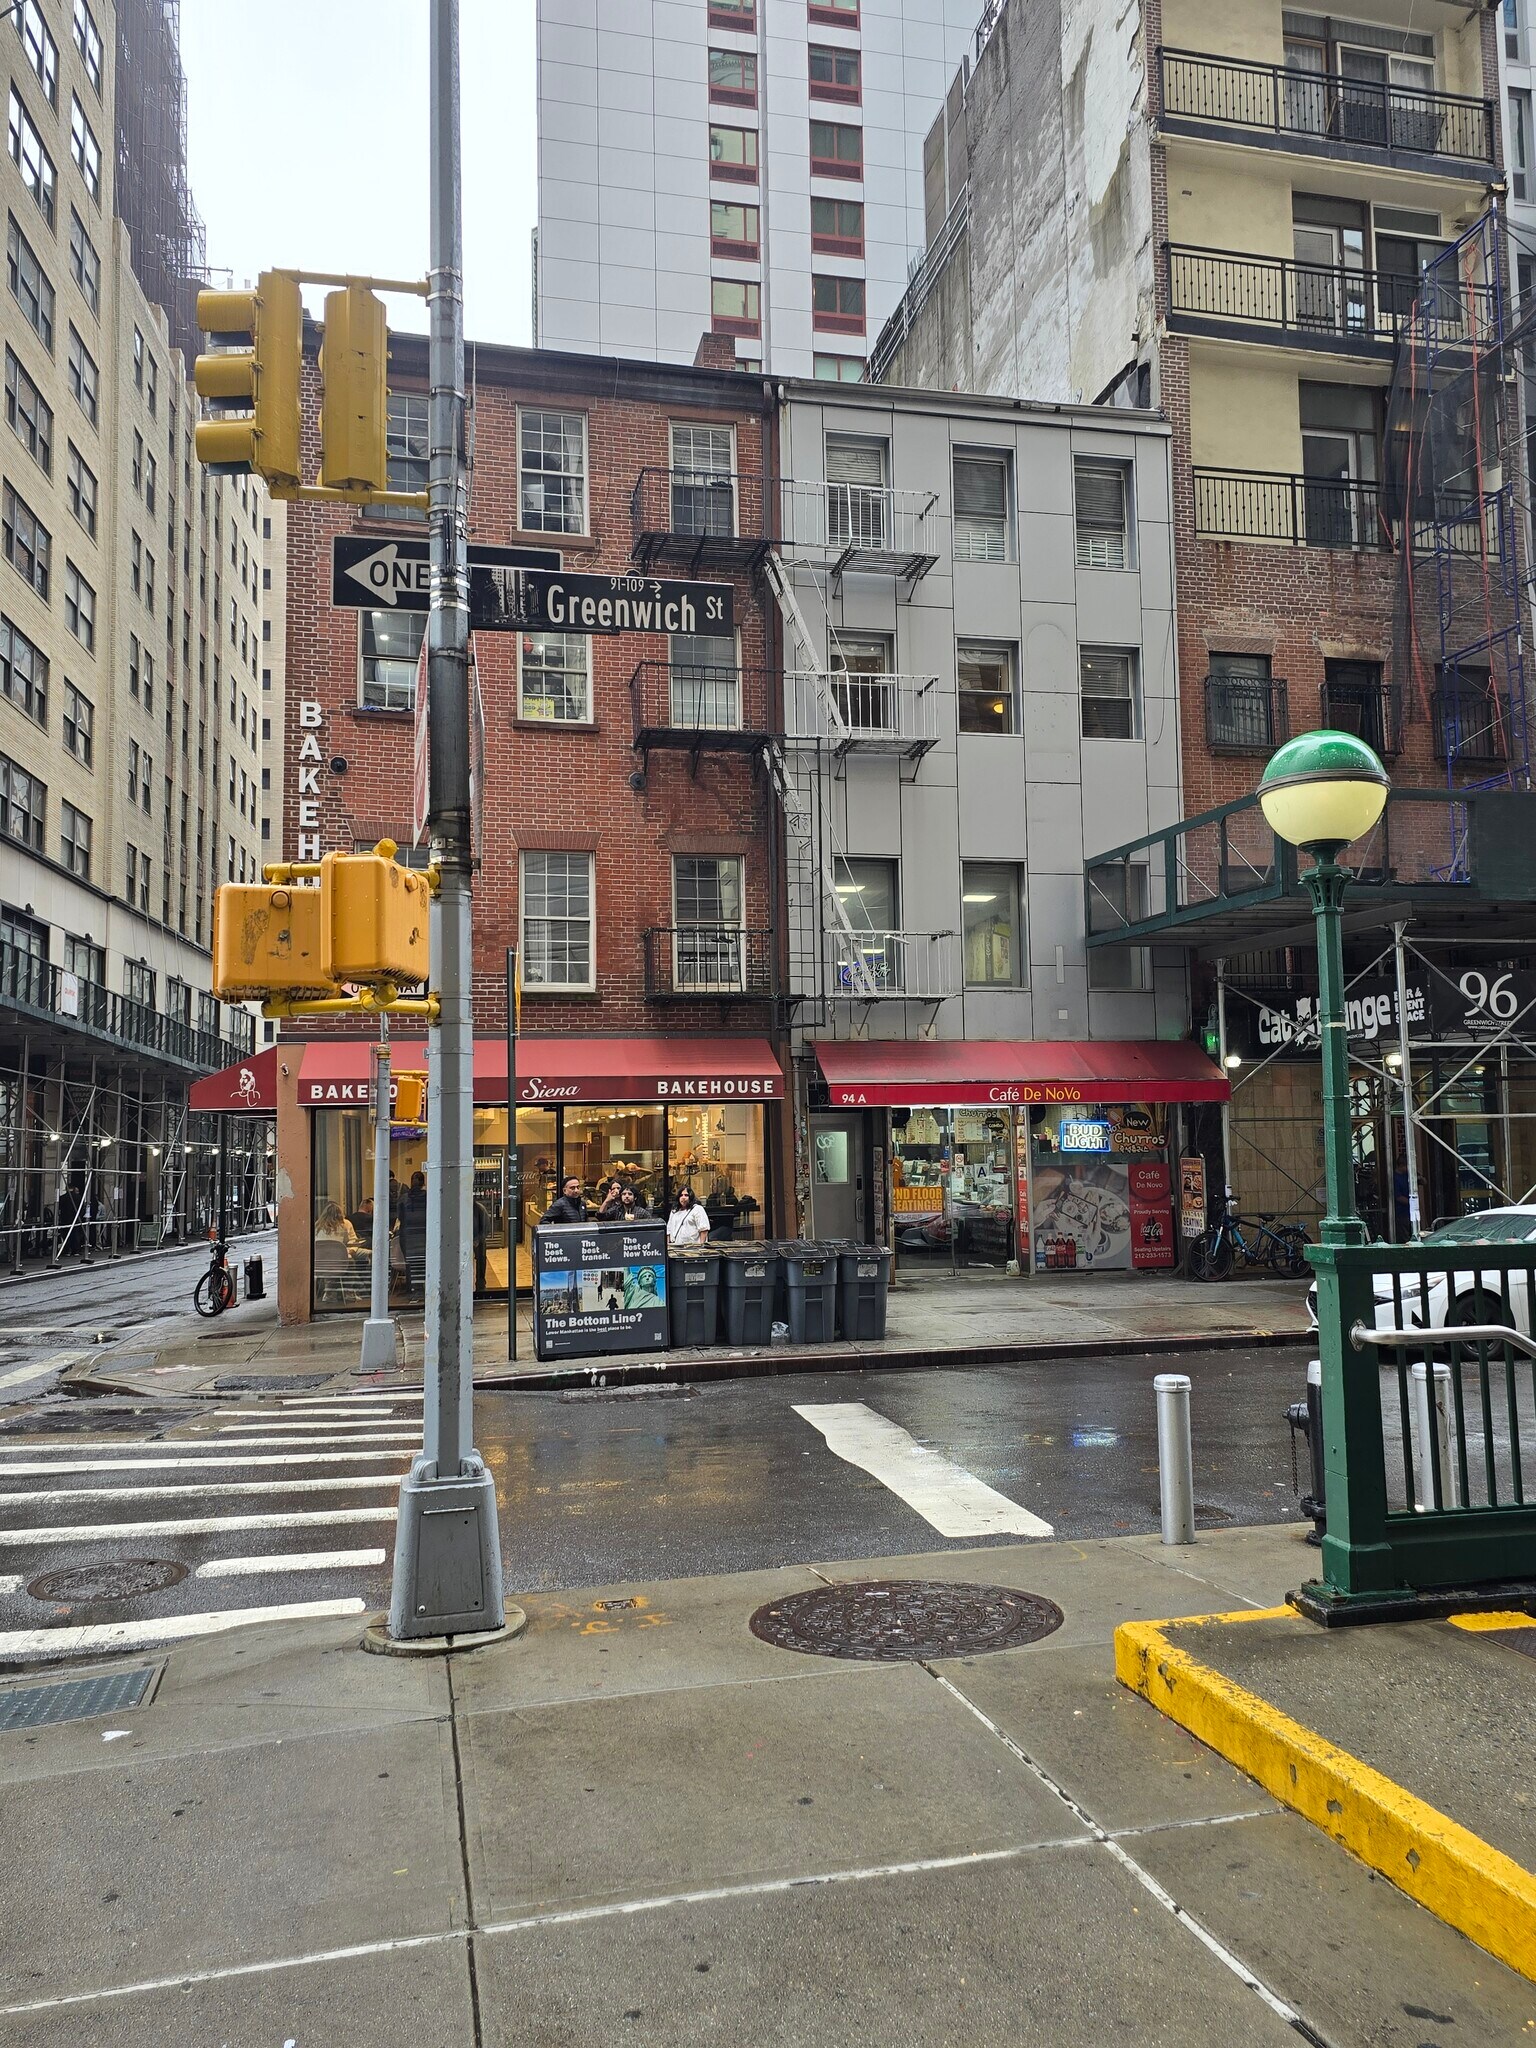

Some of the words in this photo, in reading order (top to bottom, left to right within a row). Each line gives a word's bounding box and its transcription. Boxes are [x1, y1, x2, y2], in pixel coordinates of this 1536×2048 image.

[370, 560, 430, 590] ONE
[610, 577, 645, 592] 91-109
[547, 584, 696, 632] Greenwich
[706, 595, 724, 620] St
[1415, 986, 1423, 998] &
[1459, 971, 1518, 1018] 96
[1395, 1009, 1425, 1024] SACE
[1259, 1008, 1293, 1044] Cat
[522, 1078, 581, 1100] Siena
[657, 1080, 774, 1094] BAKEHOUSE
[989, 1087, 1020, 1101] Café
[1024, 1087, 1041, 1101] De
[1046, 1087, 1081, 1100] NoVo
[842, 1093, 855, 1104] 94
[857, 1093, 867, 1104] A
[1126, 1116, 1149, 1127] New
[1070, 1124, 1103, 1136] BUD
[1064, 1135, 1109, 1150] LIGHT
[1114, 1132, 1165, 1145] Churros
[1138, 1170, 1160, 1180] Café
[912, 1188, 943, 1200] FLOOR
[544, 1241, 560, 1250] The
[581, 1240, 596, 1248] The
[581, 1253, 611, 1261] transit.
[641, 1249, 662, 1257] York.
[545, 1318, 566, 1329] The
[568, 1315, 610, 1327] Bottom
[612, 1312, 643, 1324] Line?
